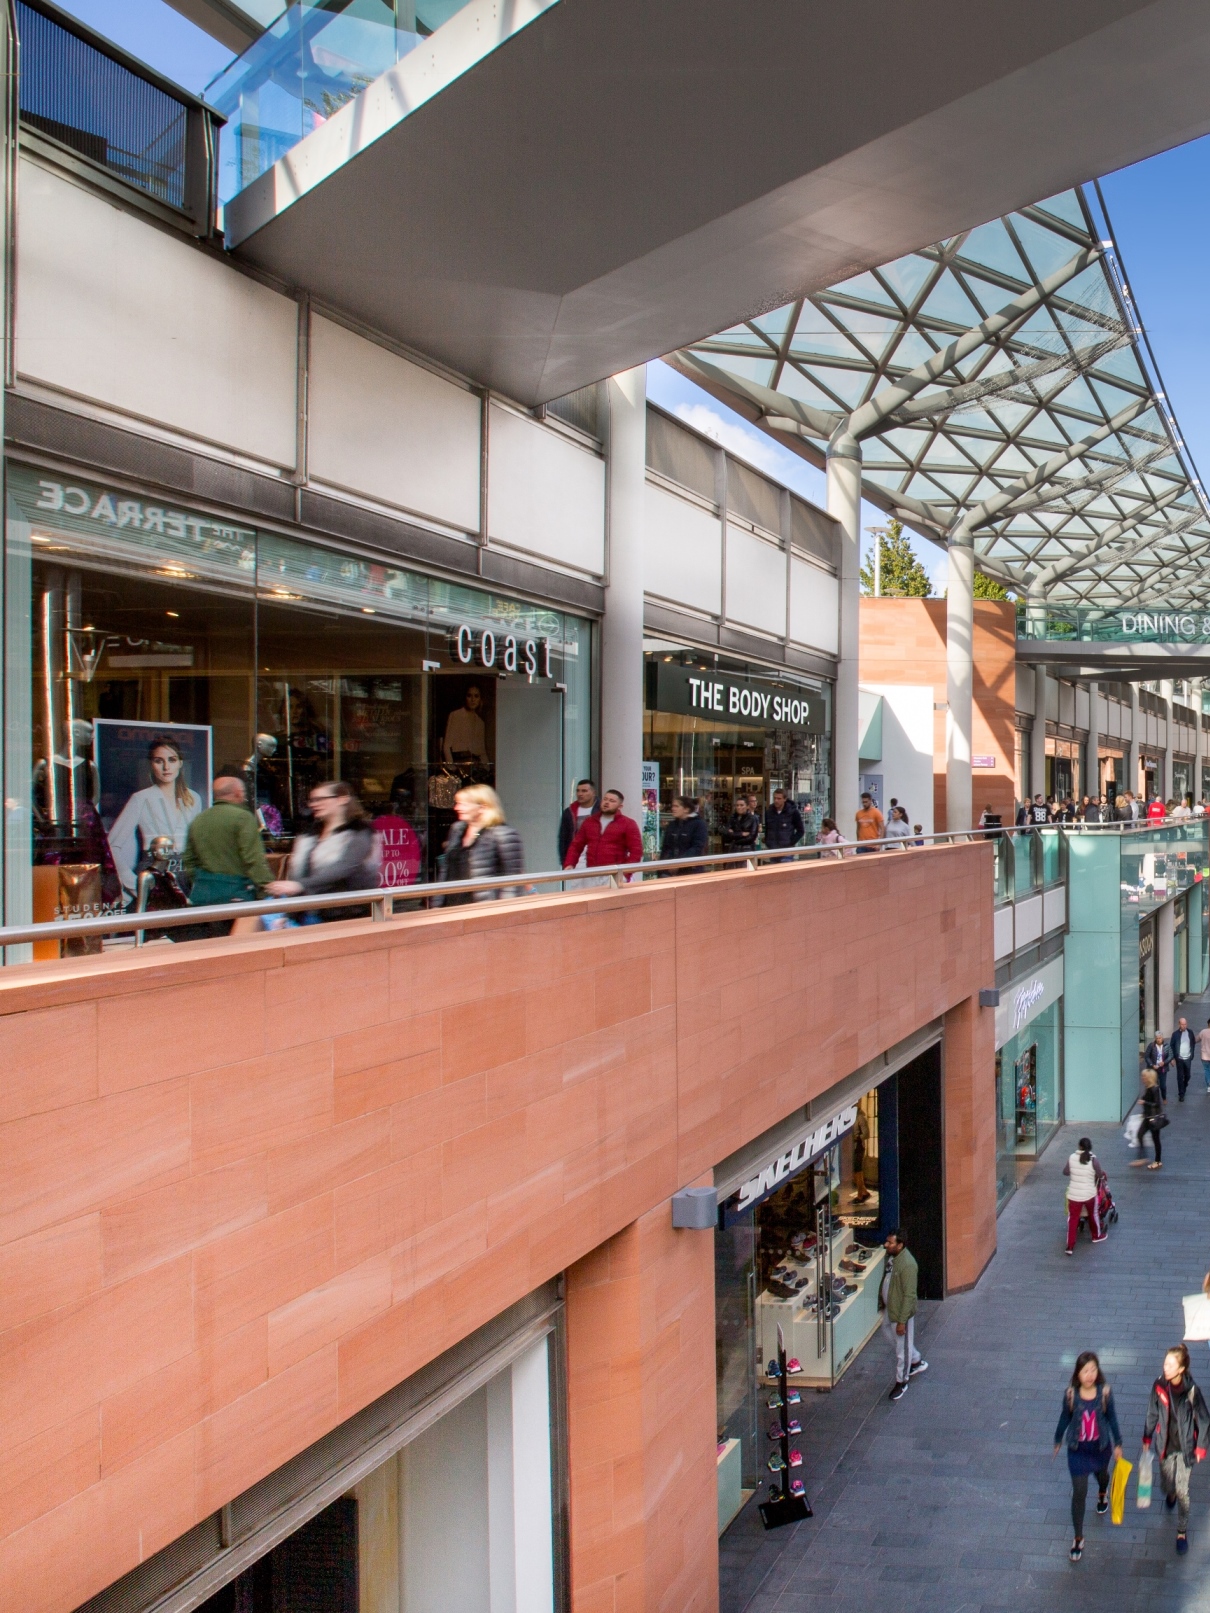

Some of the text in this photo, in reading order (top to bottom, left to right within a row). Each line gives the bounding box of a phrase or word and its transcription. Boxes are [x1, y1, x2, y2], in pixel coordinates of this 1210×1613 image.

[1122, 615, 1195, 635] DINING
[457, 624, 553, 679] coast
[689, 677, 724, 712] THE
[729, 686, 771, 719] BODY
[741, 766, 755, 776] SPA
[1035, 811, 1046, 822] 88
[381, 828, 410, 846] ALE
[53, 900, 127, 915] STUDENTS
[737, 1103, 858, 1212] SKECHERS
